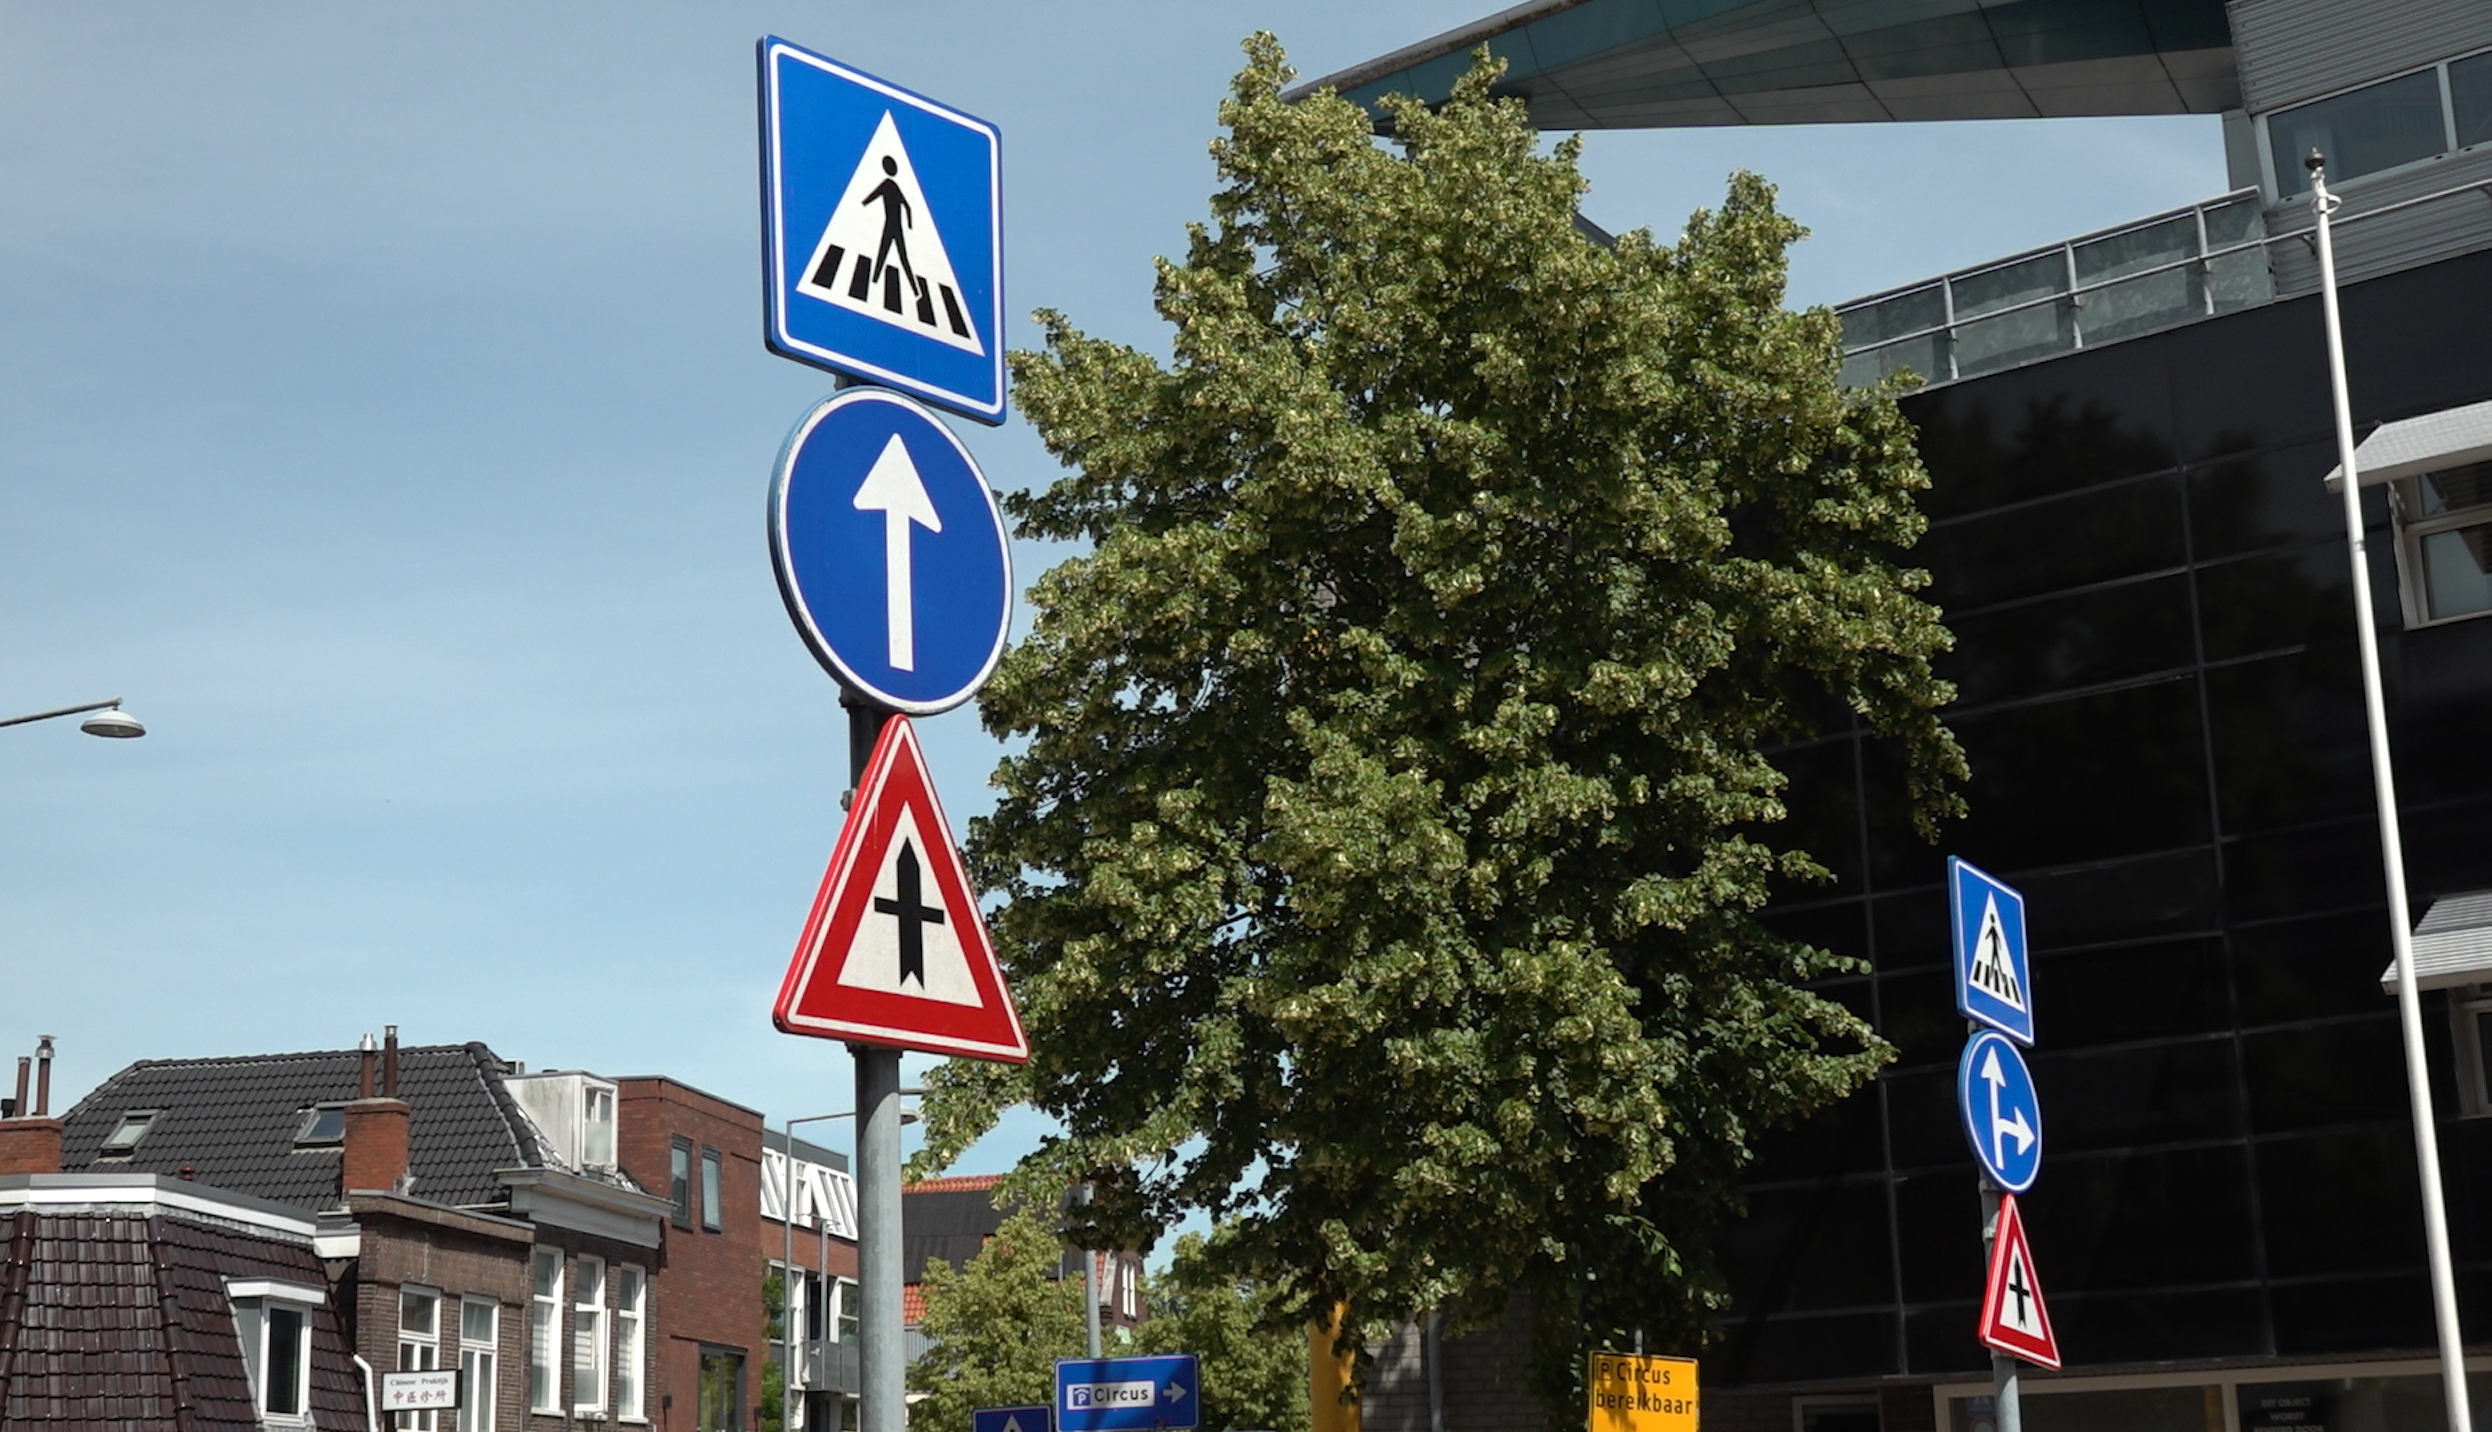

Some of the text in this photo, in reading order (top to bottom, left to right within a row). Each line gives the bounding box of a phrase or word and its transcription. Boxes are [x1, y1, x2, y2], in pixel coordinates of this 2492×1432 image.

[1601, 1362, 1671, 1385] P Circus
[1094, 1387, 1149, 1402] Circus
[1596, 1387, 1693, 1415] bereikbaar
